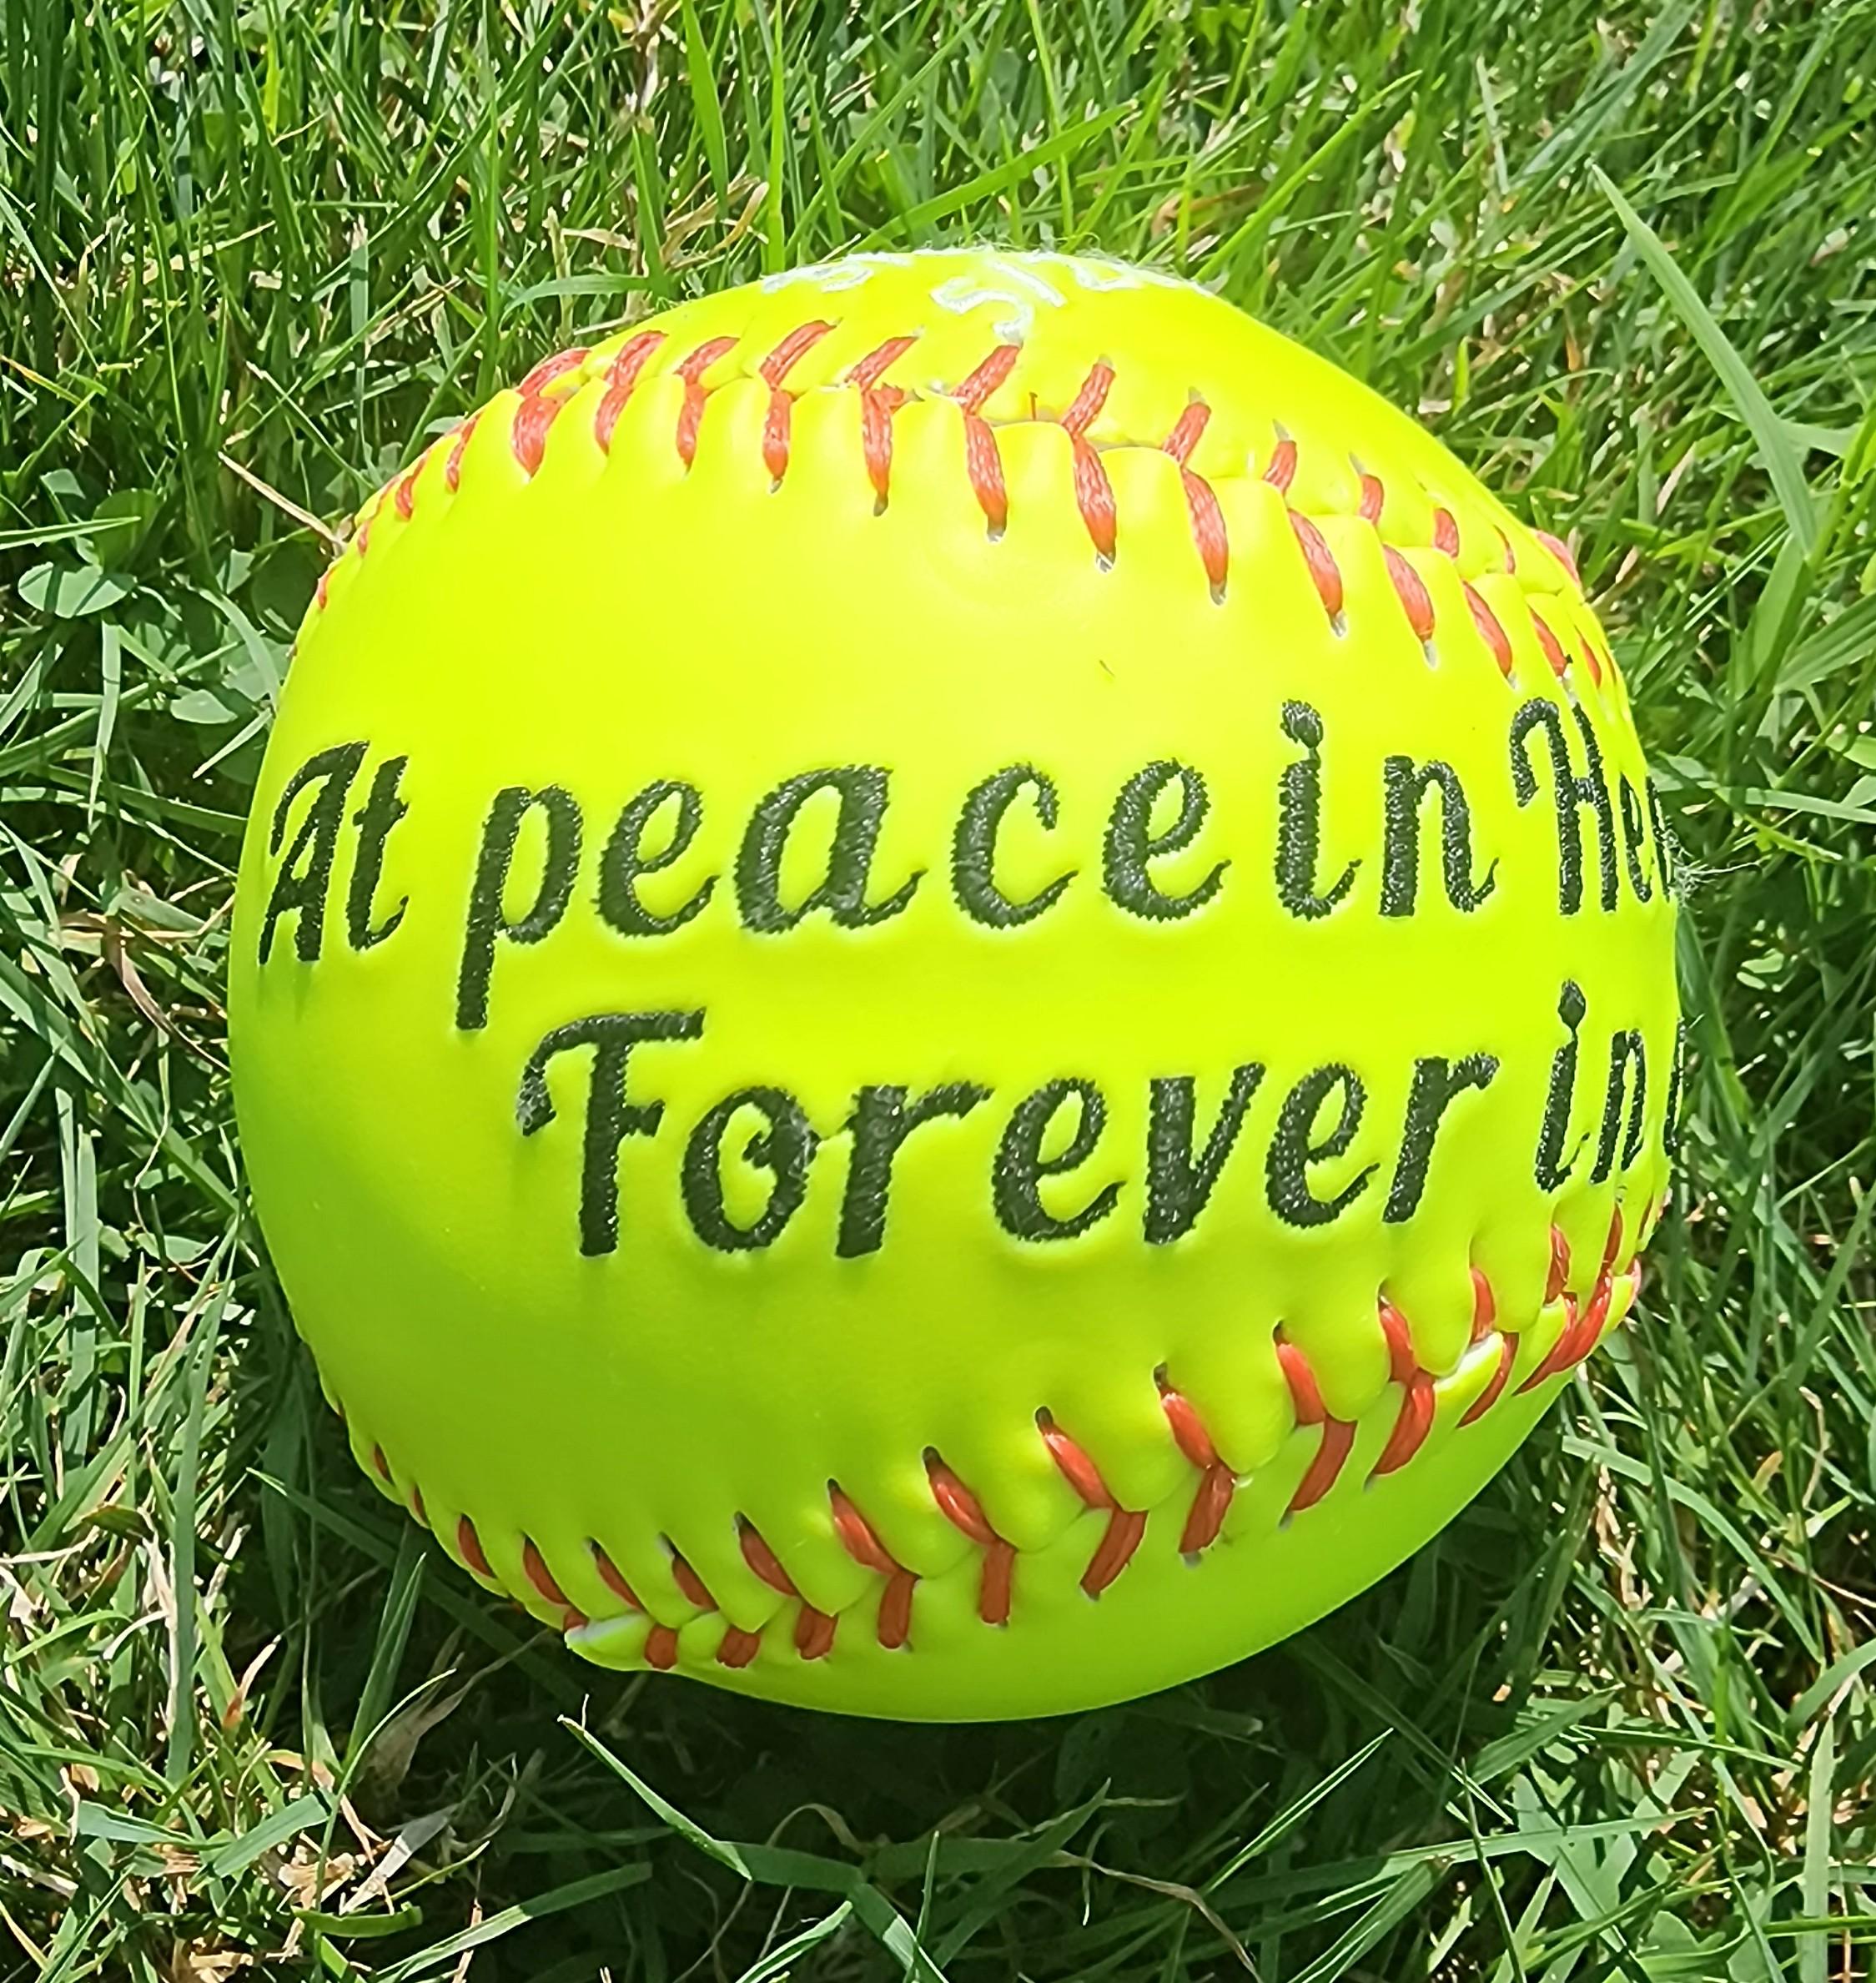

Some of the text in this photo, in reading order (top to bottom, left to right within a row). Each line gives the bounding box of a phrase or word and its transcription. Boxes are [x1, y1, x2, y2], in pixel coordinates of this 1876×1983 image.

[259, 742, 409, 964] At
[456, 760, 1226, 1030] peace
[1275, 702, 1499, 921] in
[516, 1010, 1500, 1258] Forever
[1535, 980, 1647, 1193] in
